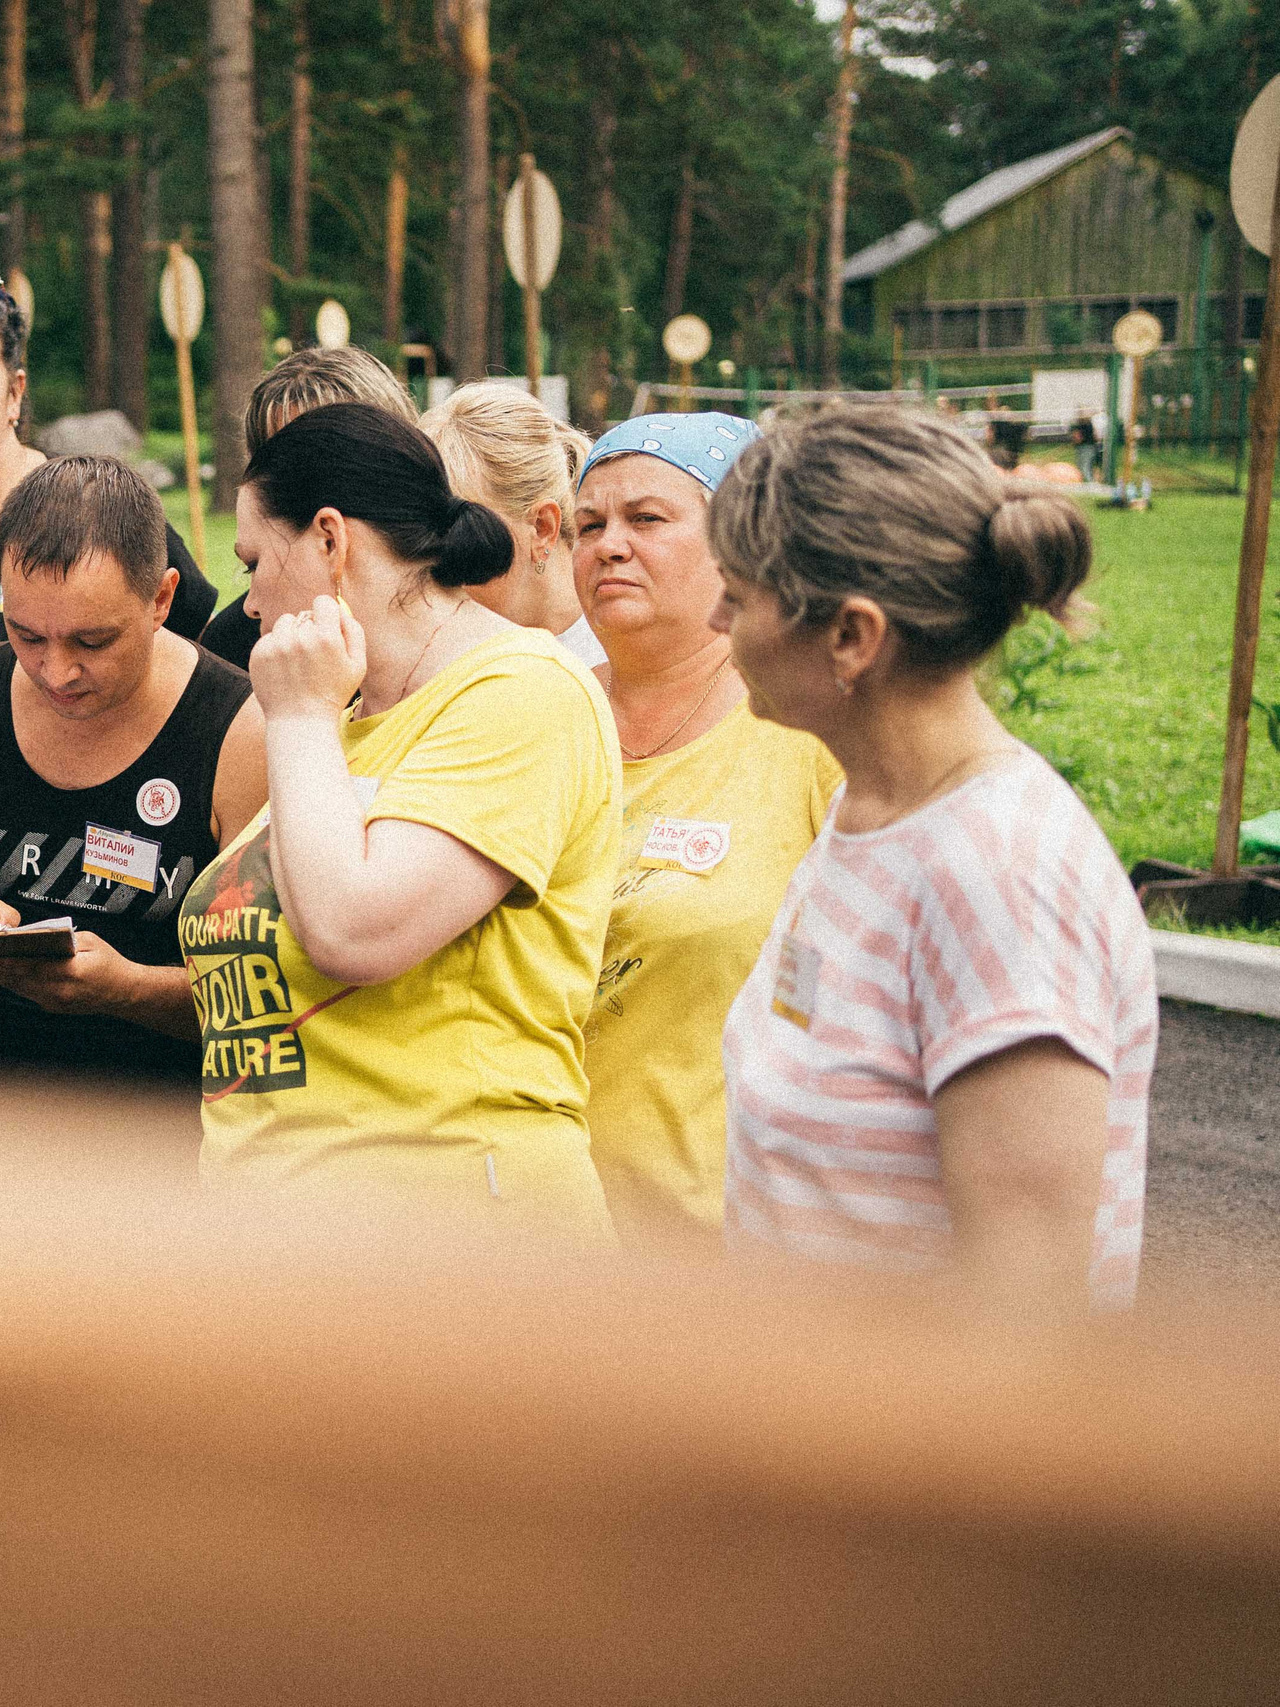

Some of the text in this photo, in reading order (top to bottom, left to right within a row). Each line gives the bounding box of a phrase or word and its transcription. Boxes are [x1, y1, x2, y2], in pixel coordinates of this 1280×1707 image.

[652, 826, 690, 839] ТАТЬЯ
[87, 834, 135, 856] ВИТАЛИЙ
[645, 841, 679, 852] НОСКОВ
[85, 848, 129, 867] КУЗЬМИНОВ
[180, 906, 284, 948] YOUR PATH
[193, 954, 292, 1036] YOUR
